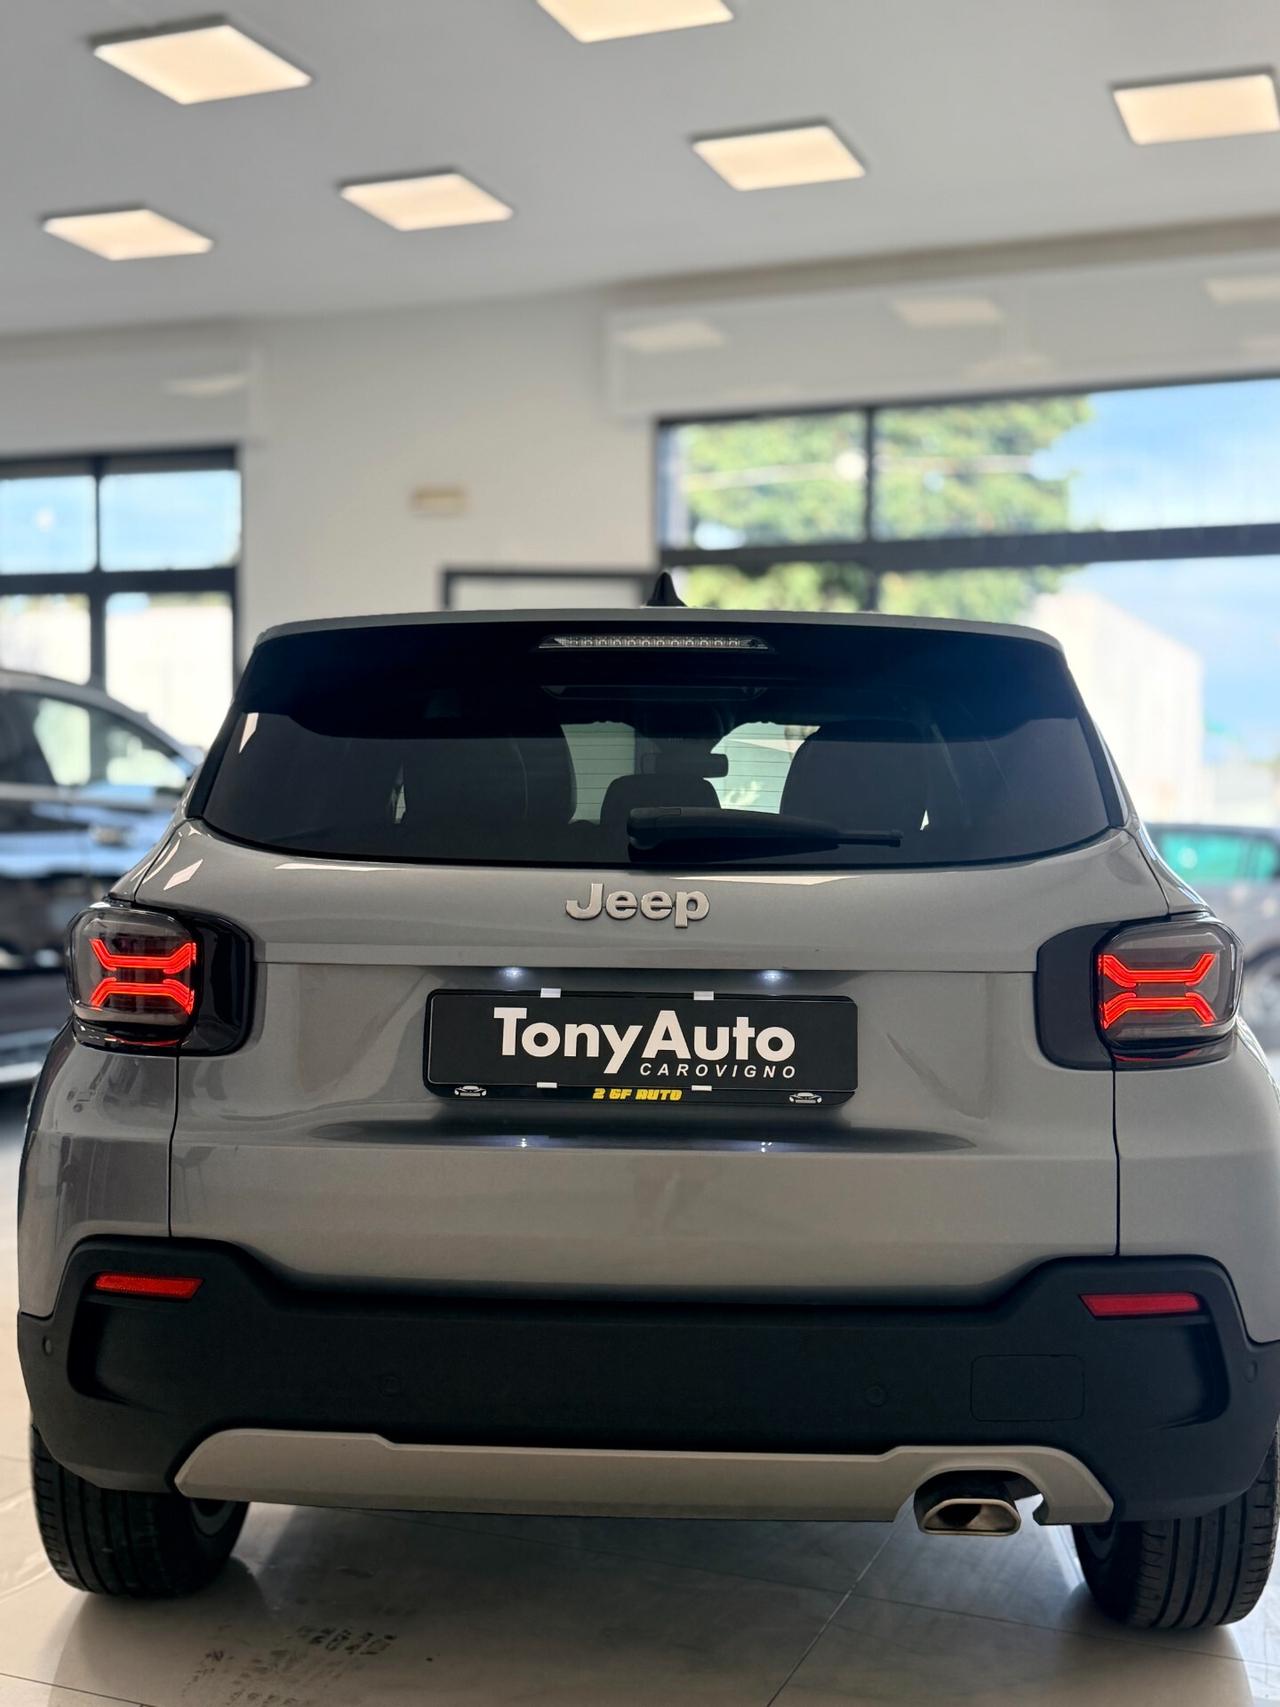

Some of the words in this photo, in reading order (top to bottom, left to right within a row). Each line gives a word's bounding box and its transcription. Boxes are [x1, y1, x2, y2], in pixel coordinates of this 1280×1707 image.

[565, 883, 710, 928] Jeep
[639, 1062, 797, 1079] CAROVIGNO
[592, 1087, 606, 1100] 2
[635, 1088, 683, 1101] AUTO
